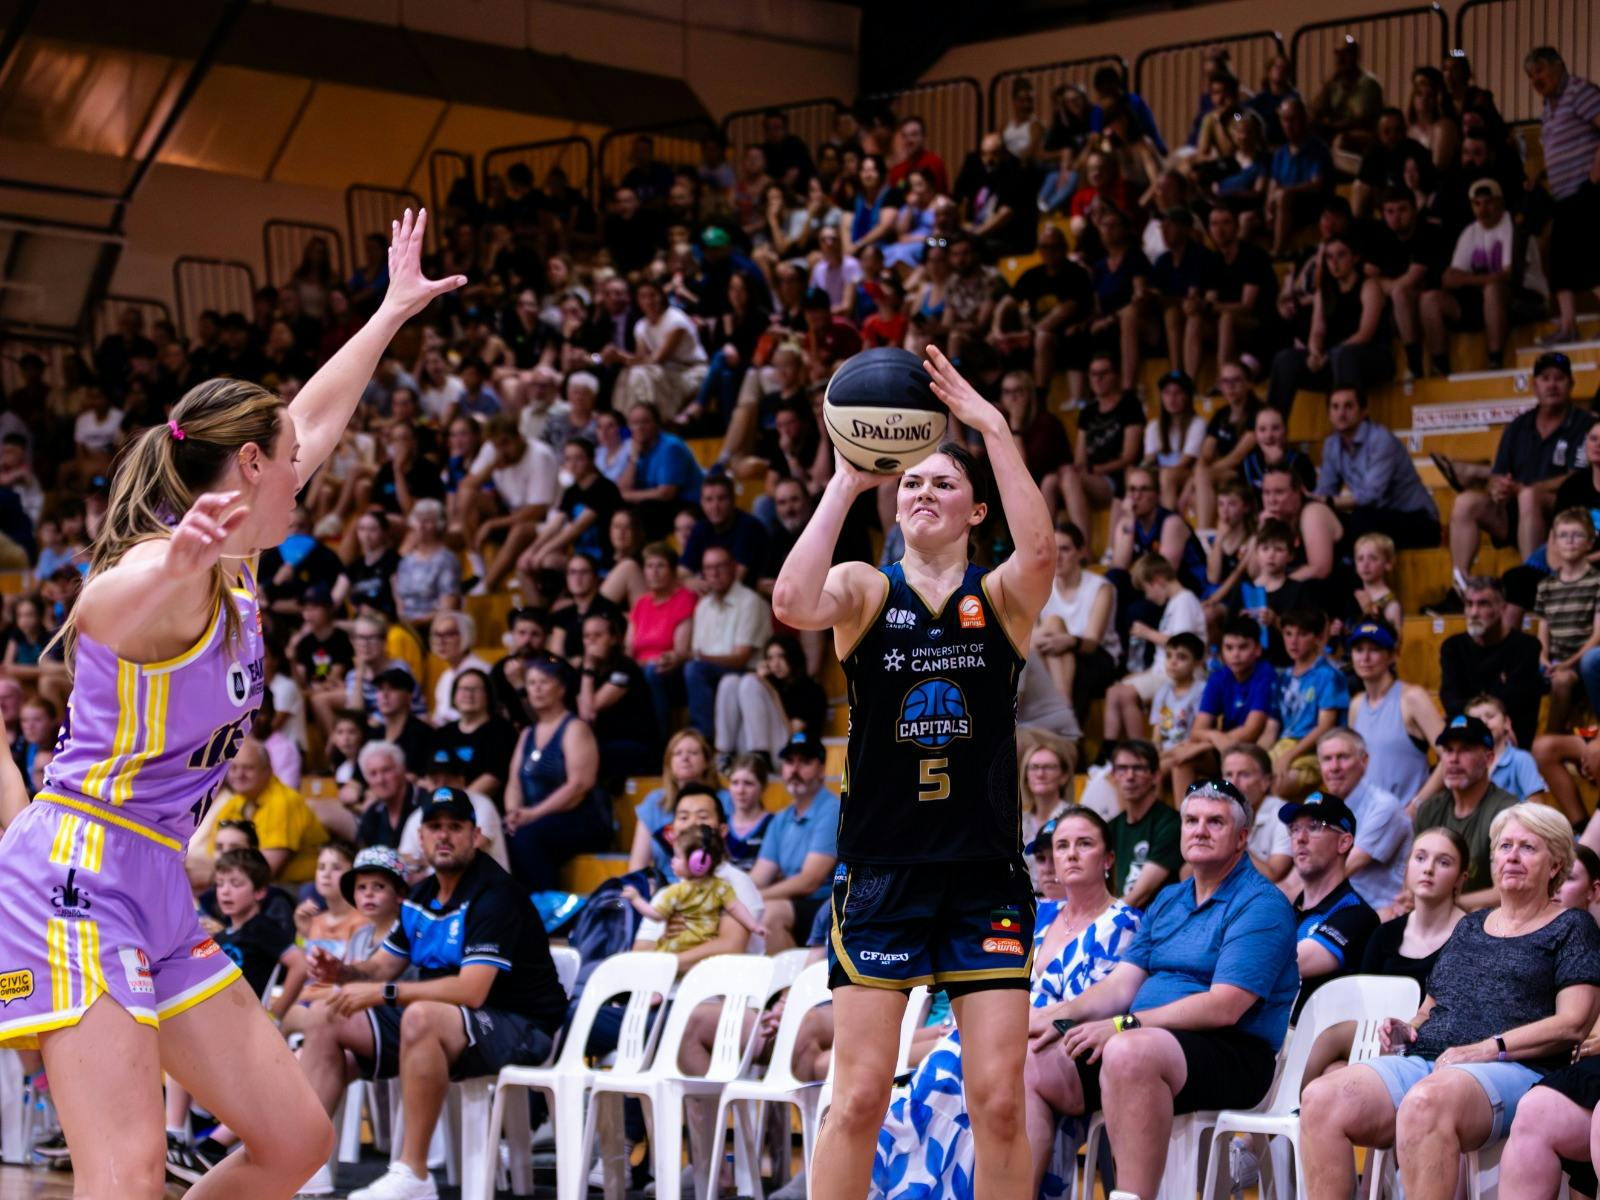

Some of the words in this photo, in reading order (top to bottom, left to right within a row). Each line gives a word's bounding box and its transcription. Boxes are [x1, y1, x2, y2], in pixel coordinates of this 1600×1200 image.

[851, 419, 932, 440] SPALDING
[911, 644, 967, 657] UNIVERSITY
[969, 643, 984, 653] OF
[911, 656, 986, 672] CANBERRA
[899, 719, 968, 738] CAPITALS
[918, 757, 951, 802] 5
[859, 950, 909, 962] CFMEU
[0, 974, 29, 988] CIVIC
[0, 985, 30, 996] OUTDOOR
